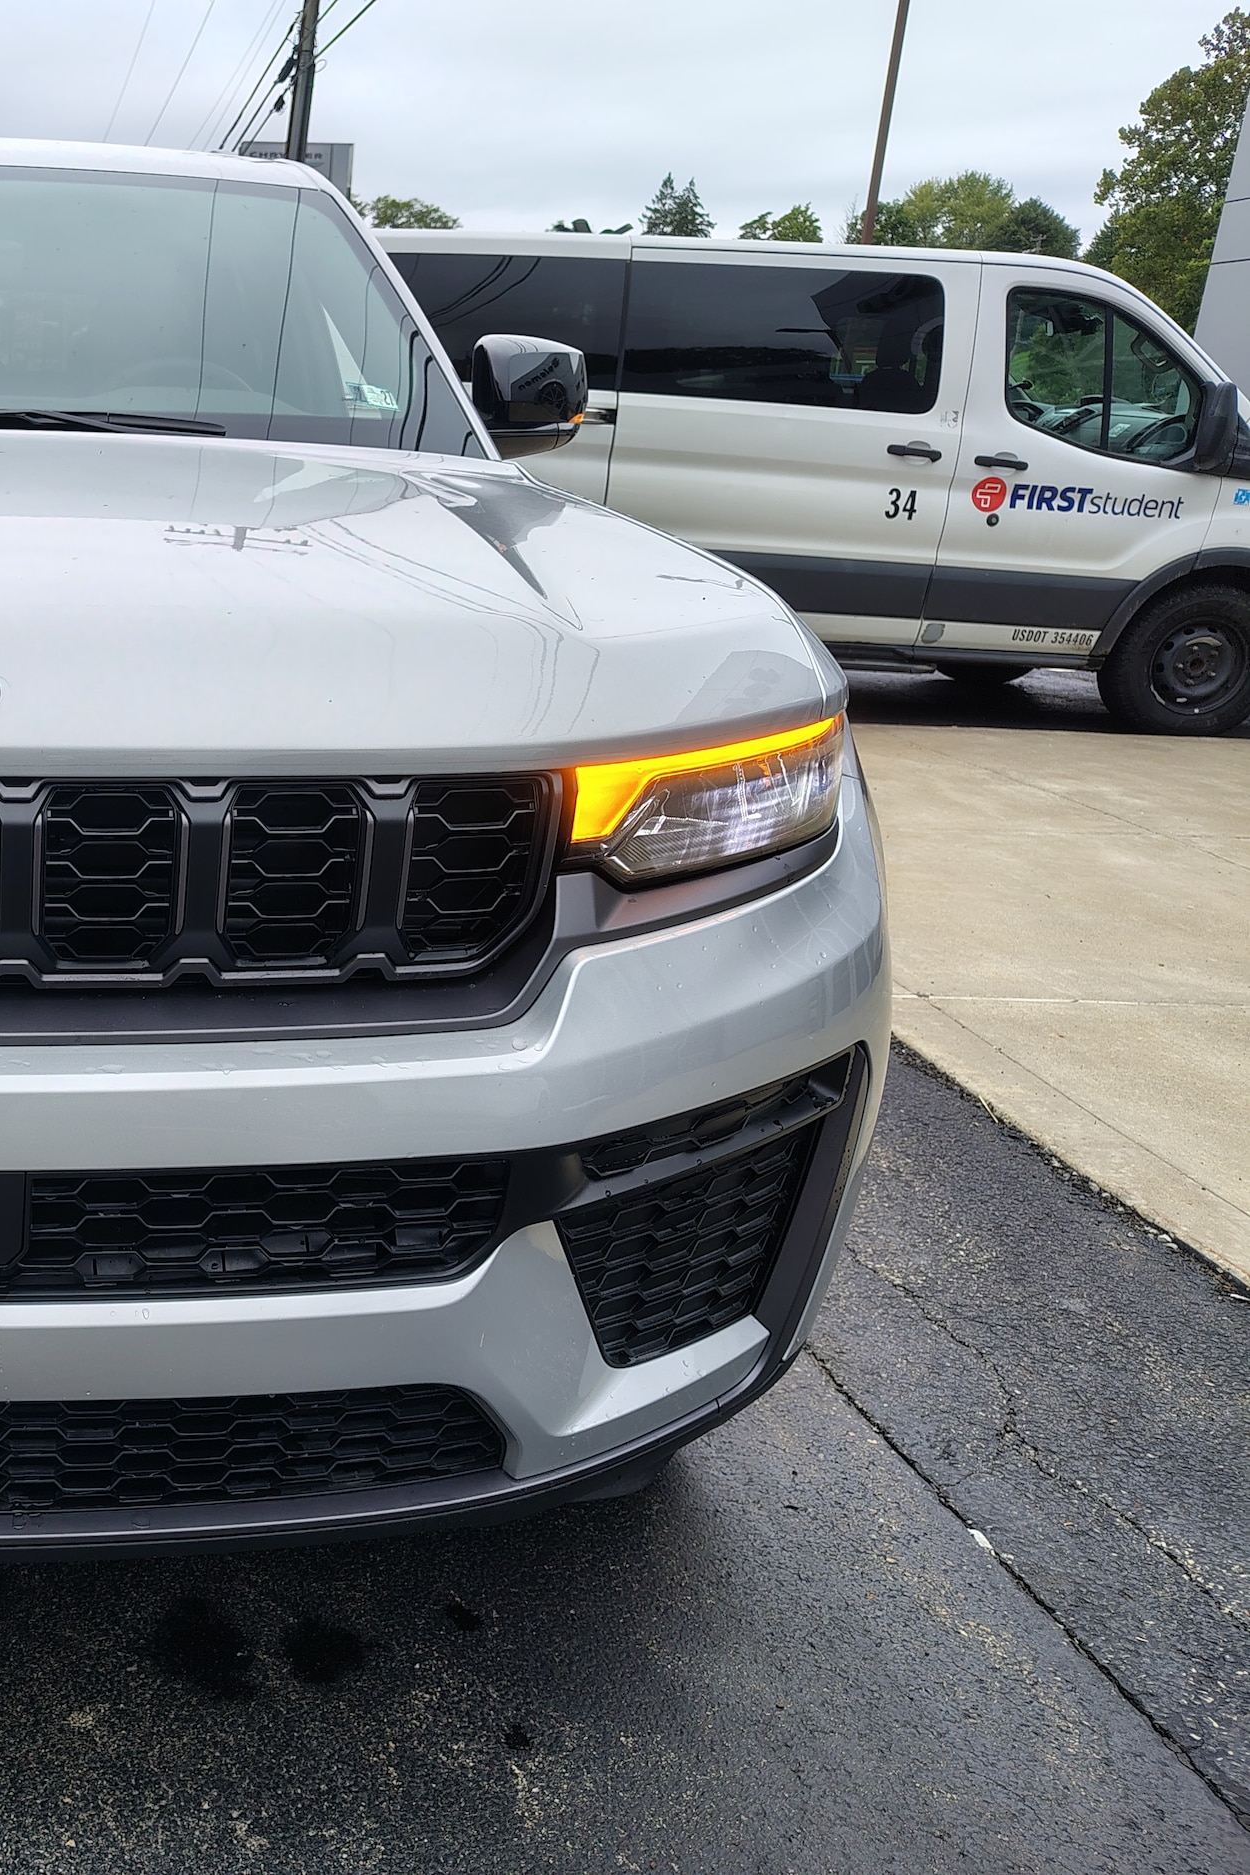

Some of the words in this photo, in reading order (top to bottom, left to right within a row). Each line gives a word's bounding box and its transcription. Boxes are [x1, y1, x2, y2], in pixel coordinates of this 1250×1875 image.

[250, 152, 323, 160] CHRYER
[884, 487, 917, 521] 34
[1012, 628, 1049, 643] USDOT
[1051, 631, 1094, 646] 354406
